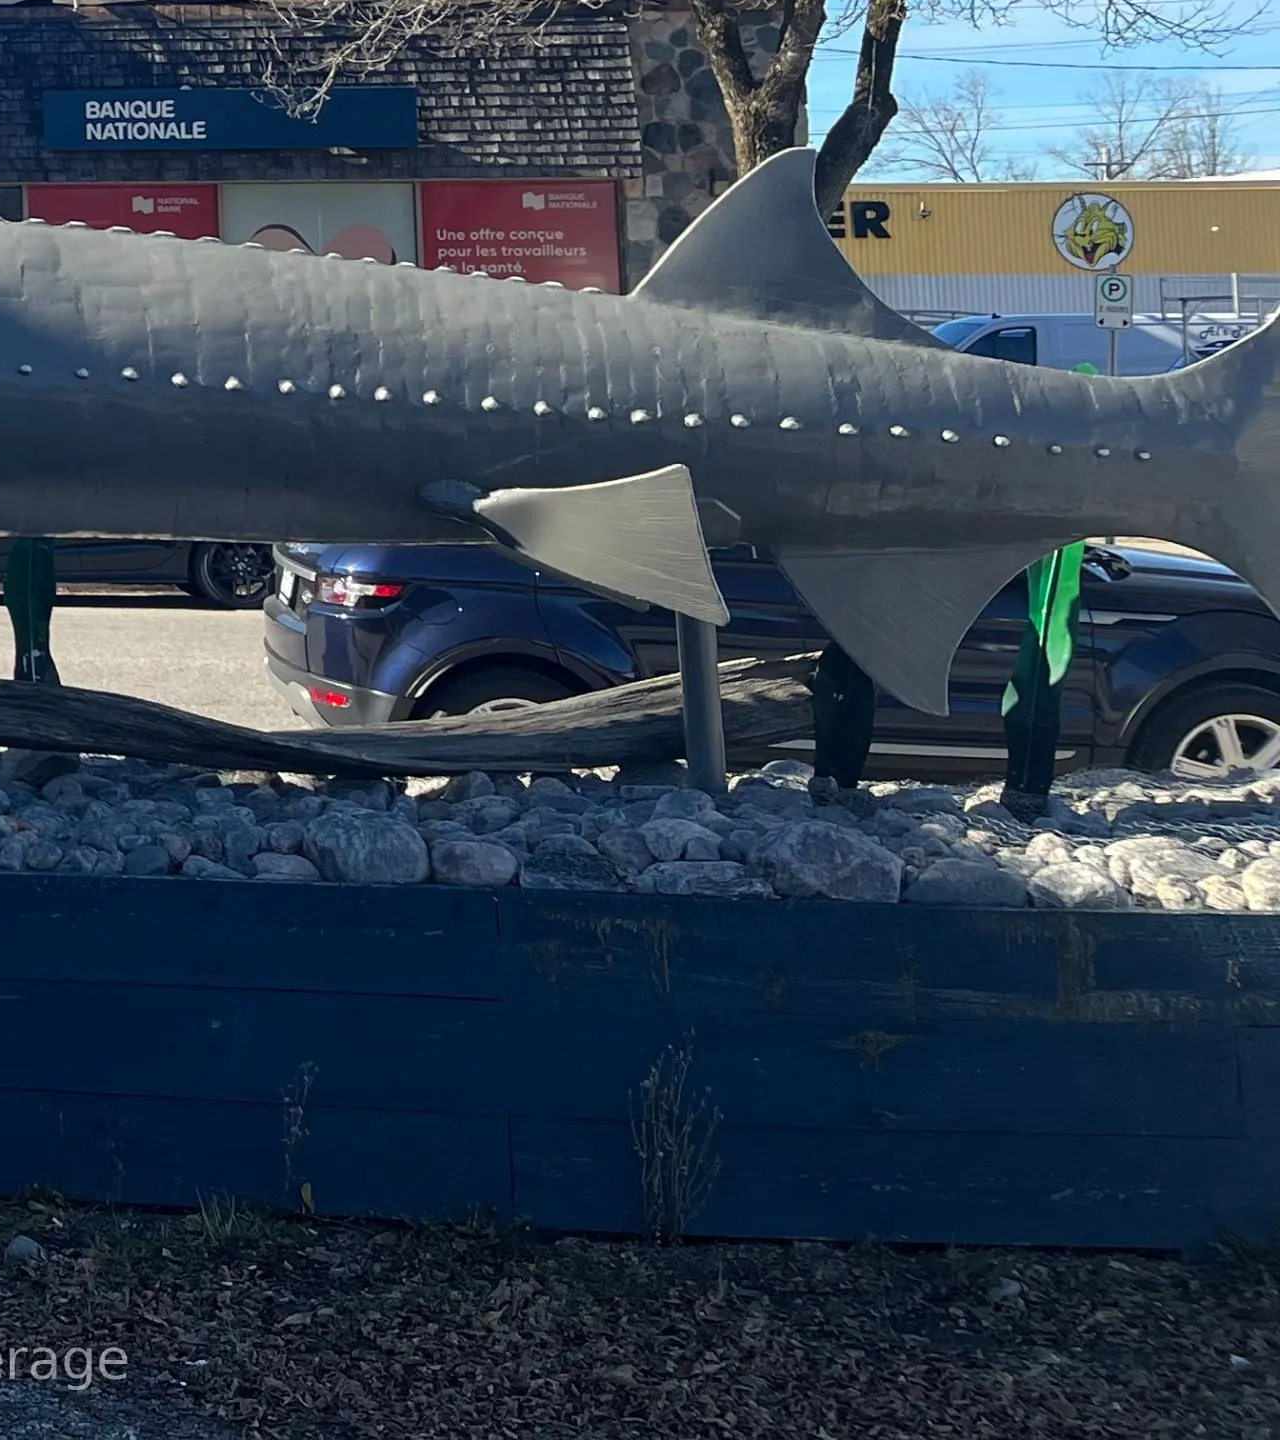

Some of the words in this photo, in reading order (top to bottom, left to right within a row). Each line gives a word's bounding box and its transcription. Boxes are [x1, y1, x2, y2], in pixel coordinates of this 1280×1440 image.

[85, 100, 176, 119] BANQUE
[85, 120, 207, 140] NATIONALE
[436, 228, 466, 241] Une
[469, 228, 505, 241] offre
[509, 229, 564, 243] conçue
[438, 246, 471, 259] pour
[476, 244, 497, 257] les
[501, 244, 587, 257] travailleurs
[462, 261, 476, 273] la
[480, 260, 527, 273] santé.
[1108, 283, 1121, 296] P
